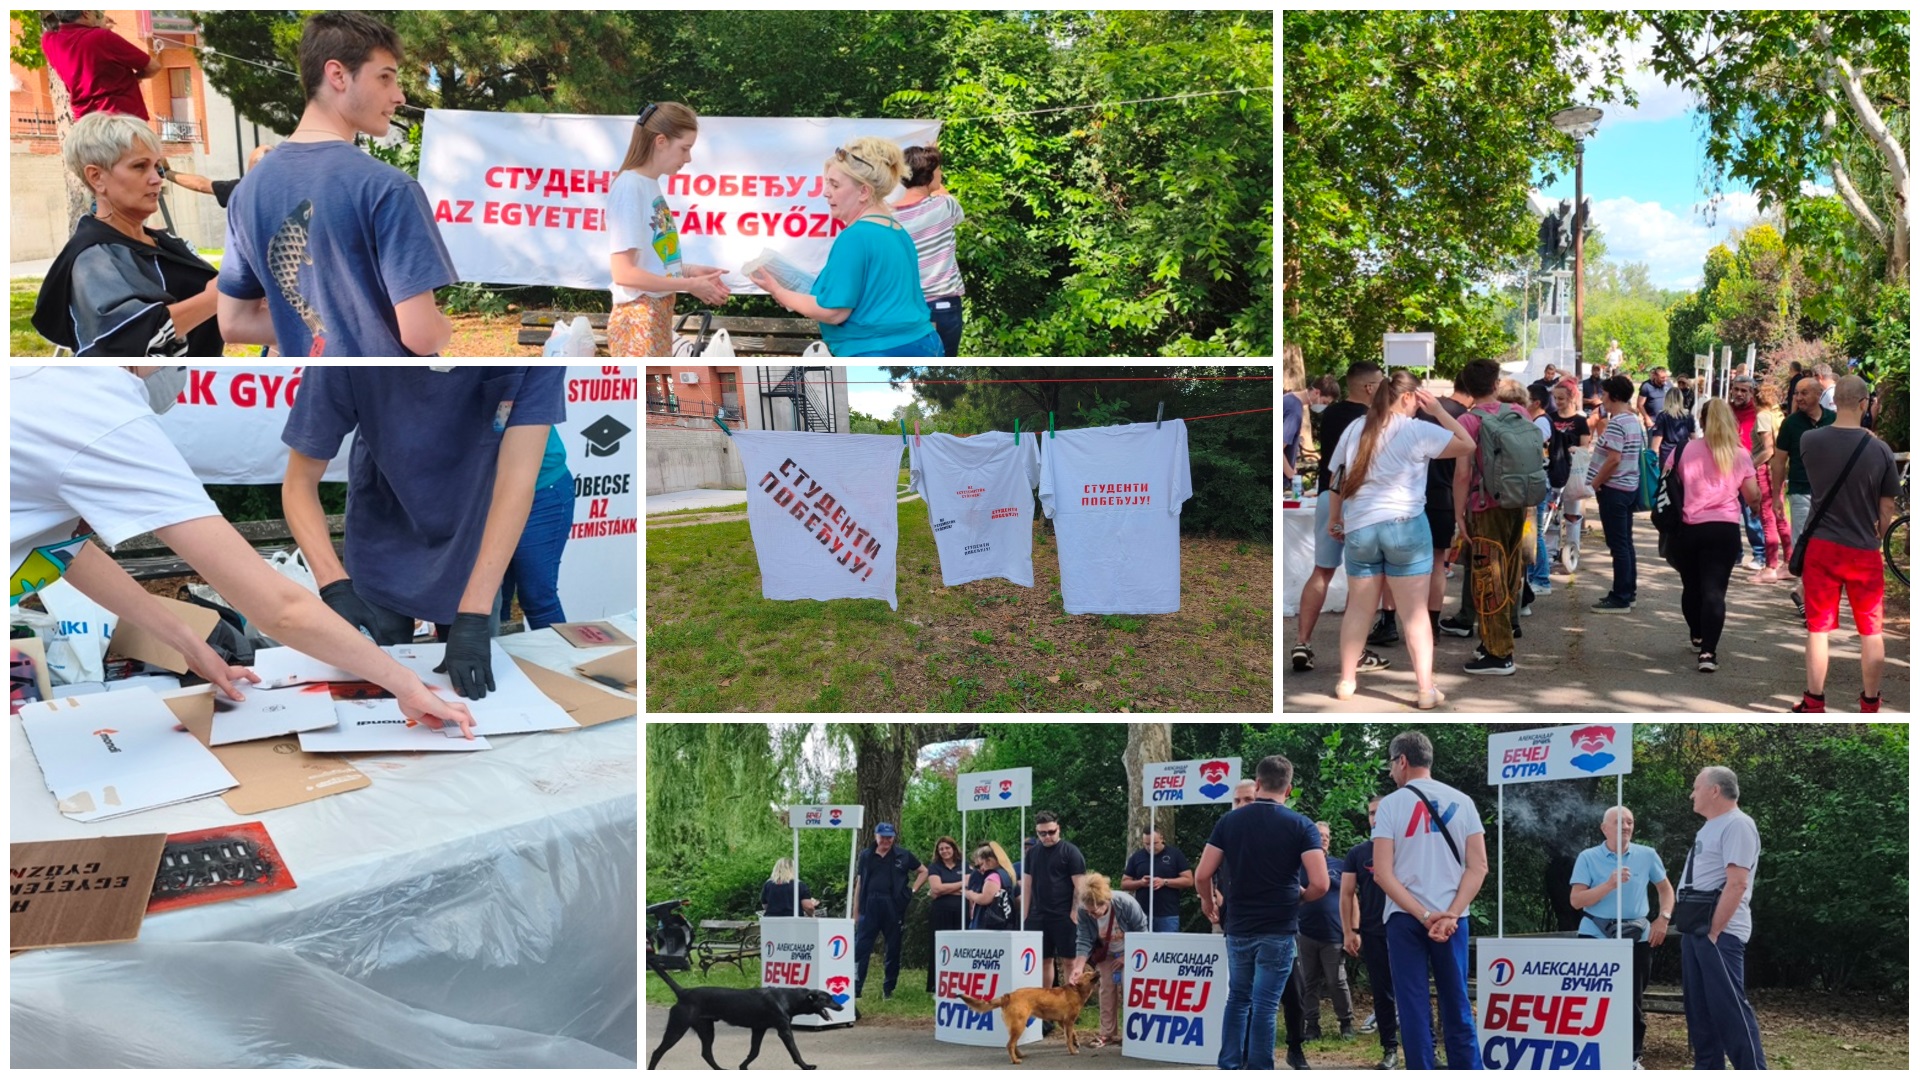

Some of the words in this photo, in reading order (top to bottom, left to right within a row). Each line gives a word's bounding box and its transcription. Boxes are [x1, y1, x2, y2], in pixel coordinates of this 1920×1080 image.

[484, 166, 619, 198] СТУДЕН
[667, 174, 823, 199] ПОБЕЂУЈ
[435, 199, 475, 223] AZ
[1083, 483, 1149, 494] СТУДЕНТИ
[589, 498, 609, 519] AZ
[779, 457, 882, 560] СТУДЕНТИ
[1503, 745, 1550, 764] БЕЧЕЈ
[1502, 762, 1547, 778] СУТРА
[1153, 776, 1186, 789] БЕЧЕЈ
[1153, 789, 1184, 801] СУТРА
[776, 943, 815, 953] АЛЕКСАНДАР
[953, 948, 1005, 960] АЛЕКСАНДАР
[972, 959, 1001, 970] ВУЧИЋ
[1152, 951, 1219, 965] АЛЕКСАНДАР
[764, 961, 810, 985] БЕЧЕЈ
[1177, 965, 1214, 977] ВУЧИЋ
[1521, 961, 1621, 977] АЛЕКСАНДАР
[938, 971, 999, 1002] БЕЧЕЈ
[1561, 977, 1613, 992] ВУЧИЋ
[1127, 977, 1212, 1014] БЕЧЕЈ
[937, 1001, 994, 1031] СУТРА
[1483, 993, 1611, 1037] БЕЧЕЈ
[1126, 1012, 1204, 1047] СУТРА
[1482, 1035, 1602, 1070] СУТРА
